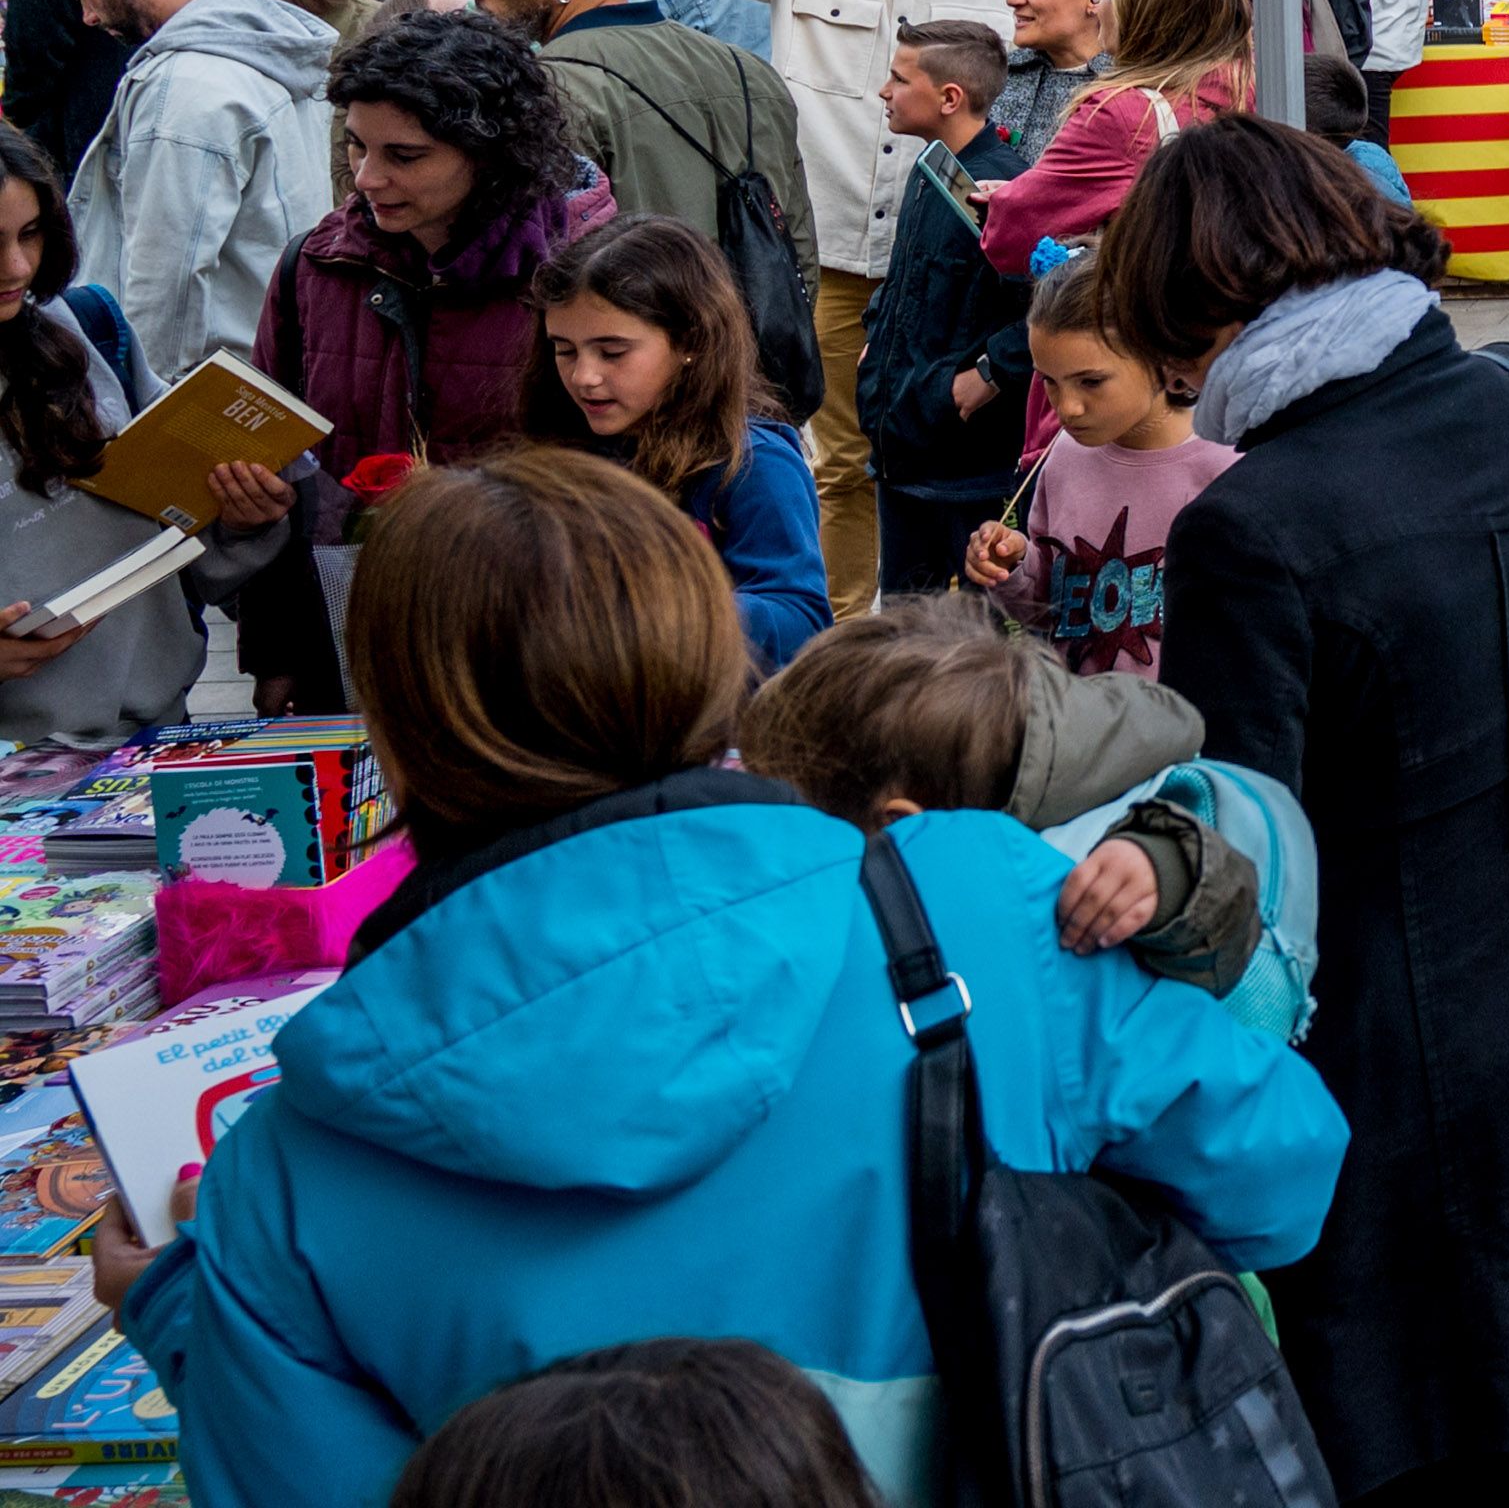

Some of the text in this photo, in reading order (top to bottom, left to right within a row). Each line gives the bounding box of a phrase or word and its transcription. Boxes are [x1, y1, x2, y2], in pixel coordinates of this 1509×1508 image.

[222, 398, 269, 432] BEN
[156, 1043, 189, 1065] El
[192, 1026, 255, 1059] petit
[202, 1047, 251, 1073] del
